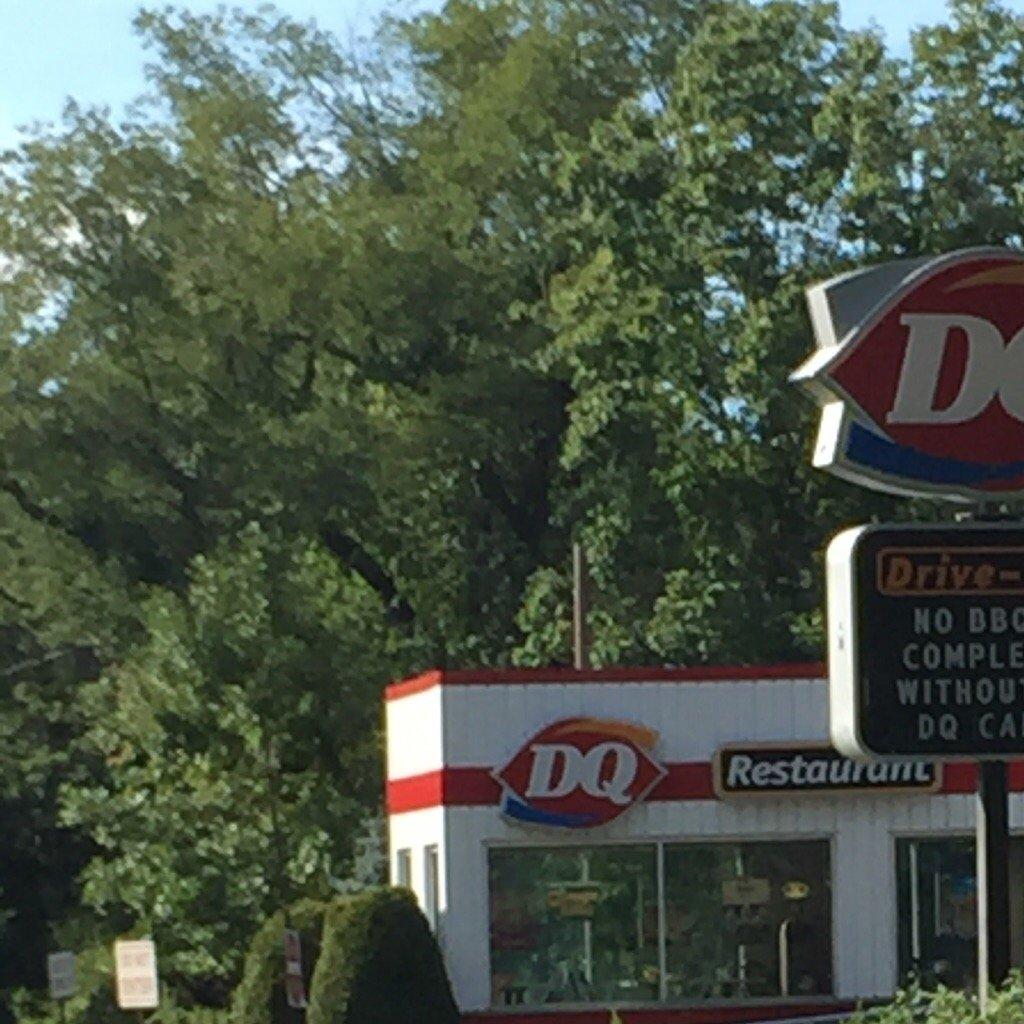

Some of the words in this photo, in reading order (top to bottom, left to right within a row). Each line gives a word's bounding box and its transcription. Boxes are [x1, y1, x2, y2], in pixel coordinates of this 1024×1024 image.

[913, 606, 953, 634] NO
[918, 713, 958, 741] DQ
[524, 742, 639, 804] DQ
